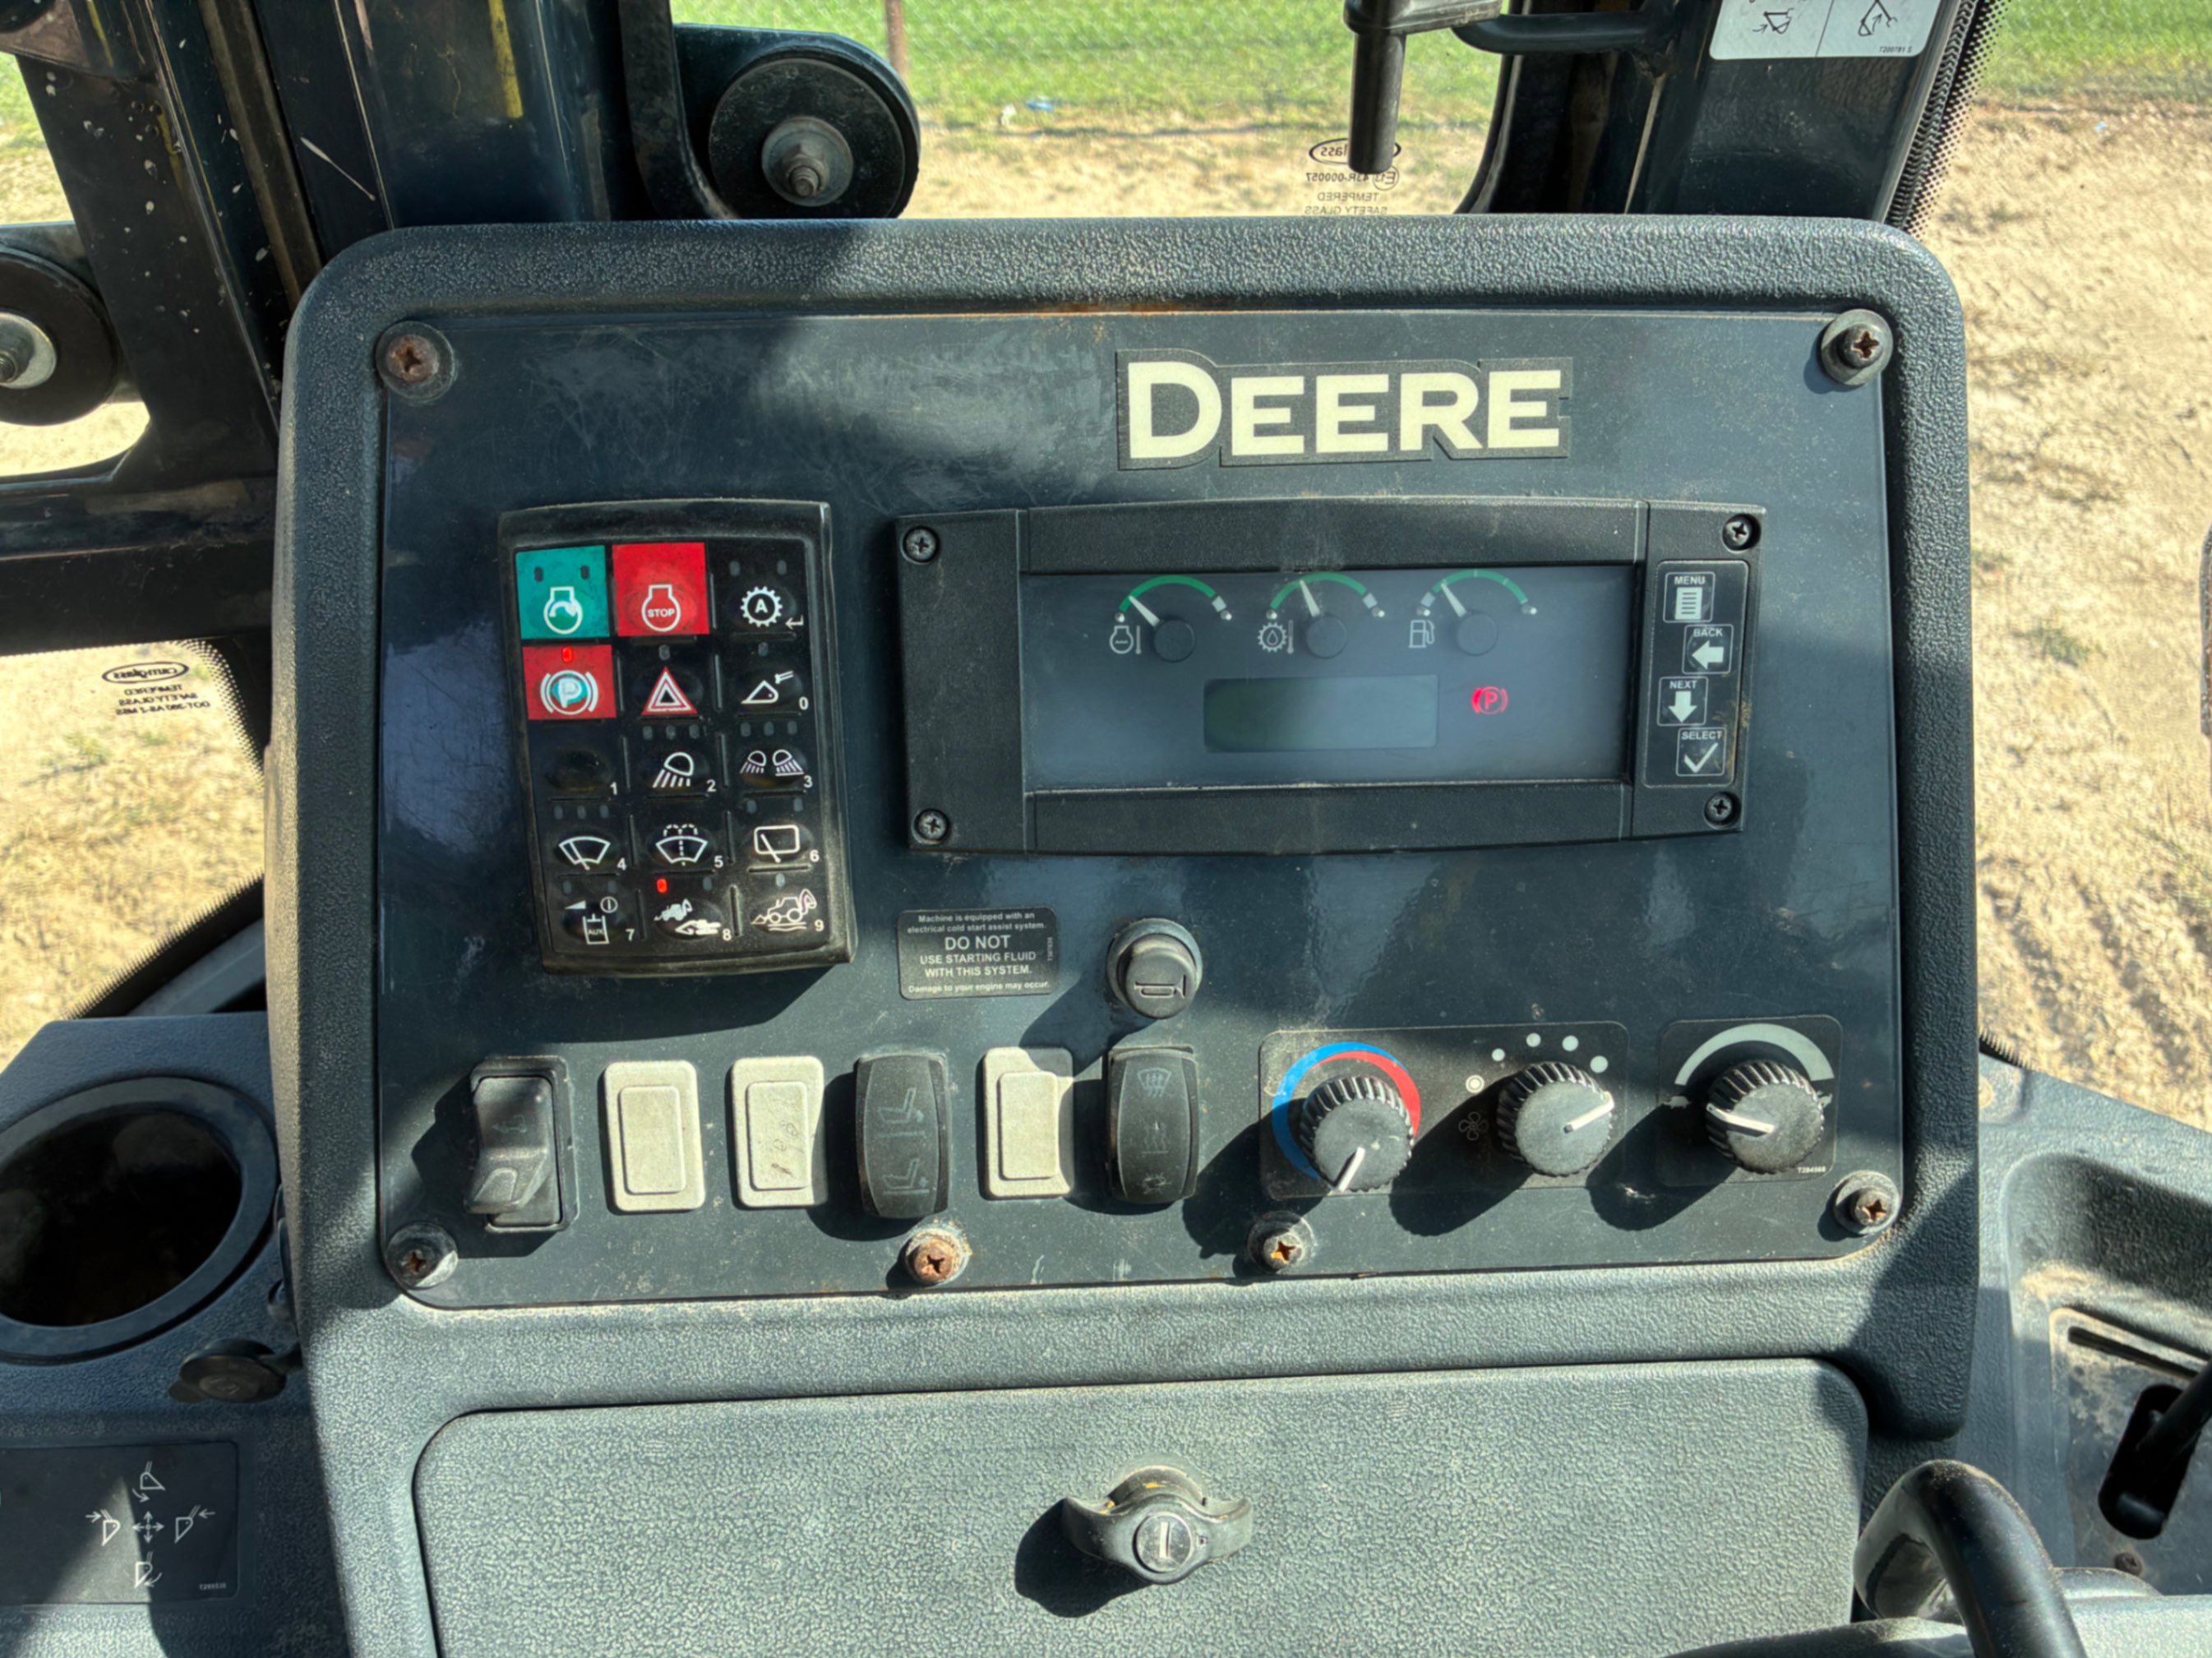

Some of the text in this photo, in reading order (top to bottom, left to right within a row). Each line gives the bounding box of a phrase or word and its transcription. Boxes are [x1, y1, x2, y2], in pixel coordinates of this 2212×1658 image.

[1127, 362, 1562, 459] DEERE
[1674, 575, 1706, 585] MENU
[755, 598, 769, 613] A
[647, 607, 675, 618] STOP
[1693, 628, 1724, 637] BACK
[1669, 681, 1697, 689] NEXT
[558, 681, 580, 709] P
[1485, 691, 1499, 709] P
[799, 697, 809, 711] 0
[1681, 731, 1722, 740] SELECT
[707, 779, 717, 792] 2
[803, 775, 813, 788] 3
[611, 782, 618, 795] 1
[713, 856, 723, 869] 5
[810, 850, 820, 863] 6
[616, 857, 627, 871] 4
[918, 914, 954, 922] Machine
[955, 913, 963, 921] is
[964, 912, 1003, 922] equipped
[815, 919, 824, 932] 9
[907, 921, 1046, 934] electrical cold start assist system.
[626, 928, 635, 941] 7
[723, 928, 732, 941] 8
[944, 935, 1011, 950] DO NOT
[920, 951, 1037, 965] USE STARTING FLUID
[925, 964, 1032, 978] WITH THIS SYSTEM.
[908, 985, 942, 994] Damage
[954, 985, 973, 993] your
[975, 982, 1003, 991] engine
[1004, 982, 1023, 991] may
[1024, 981, 1051, 989] occur.
